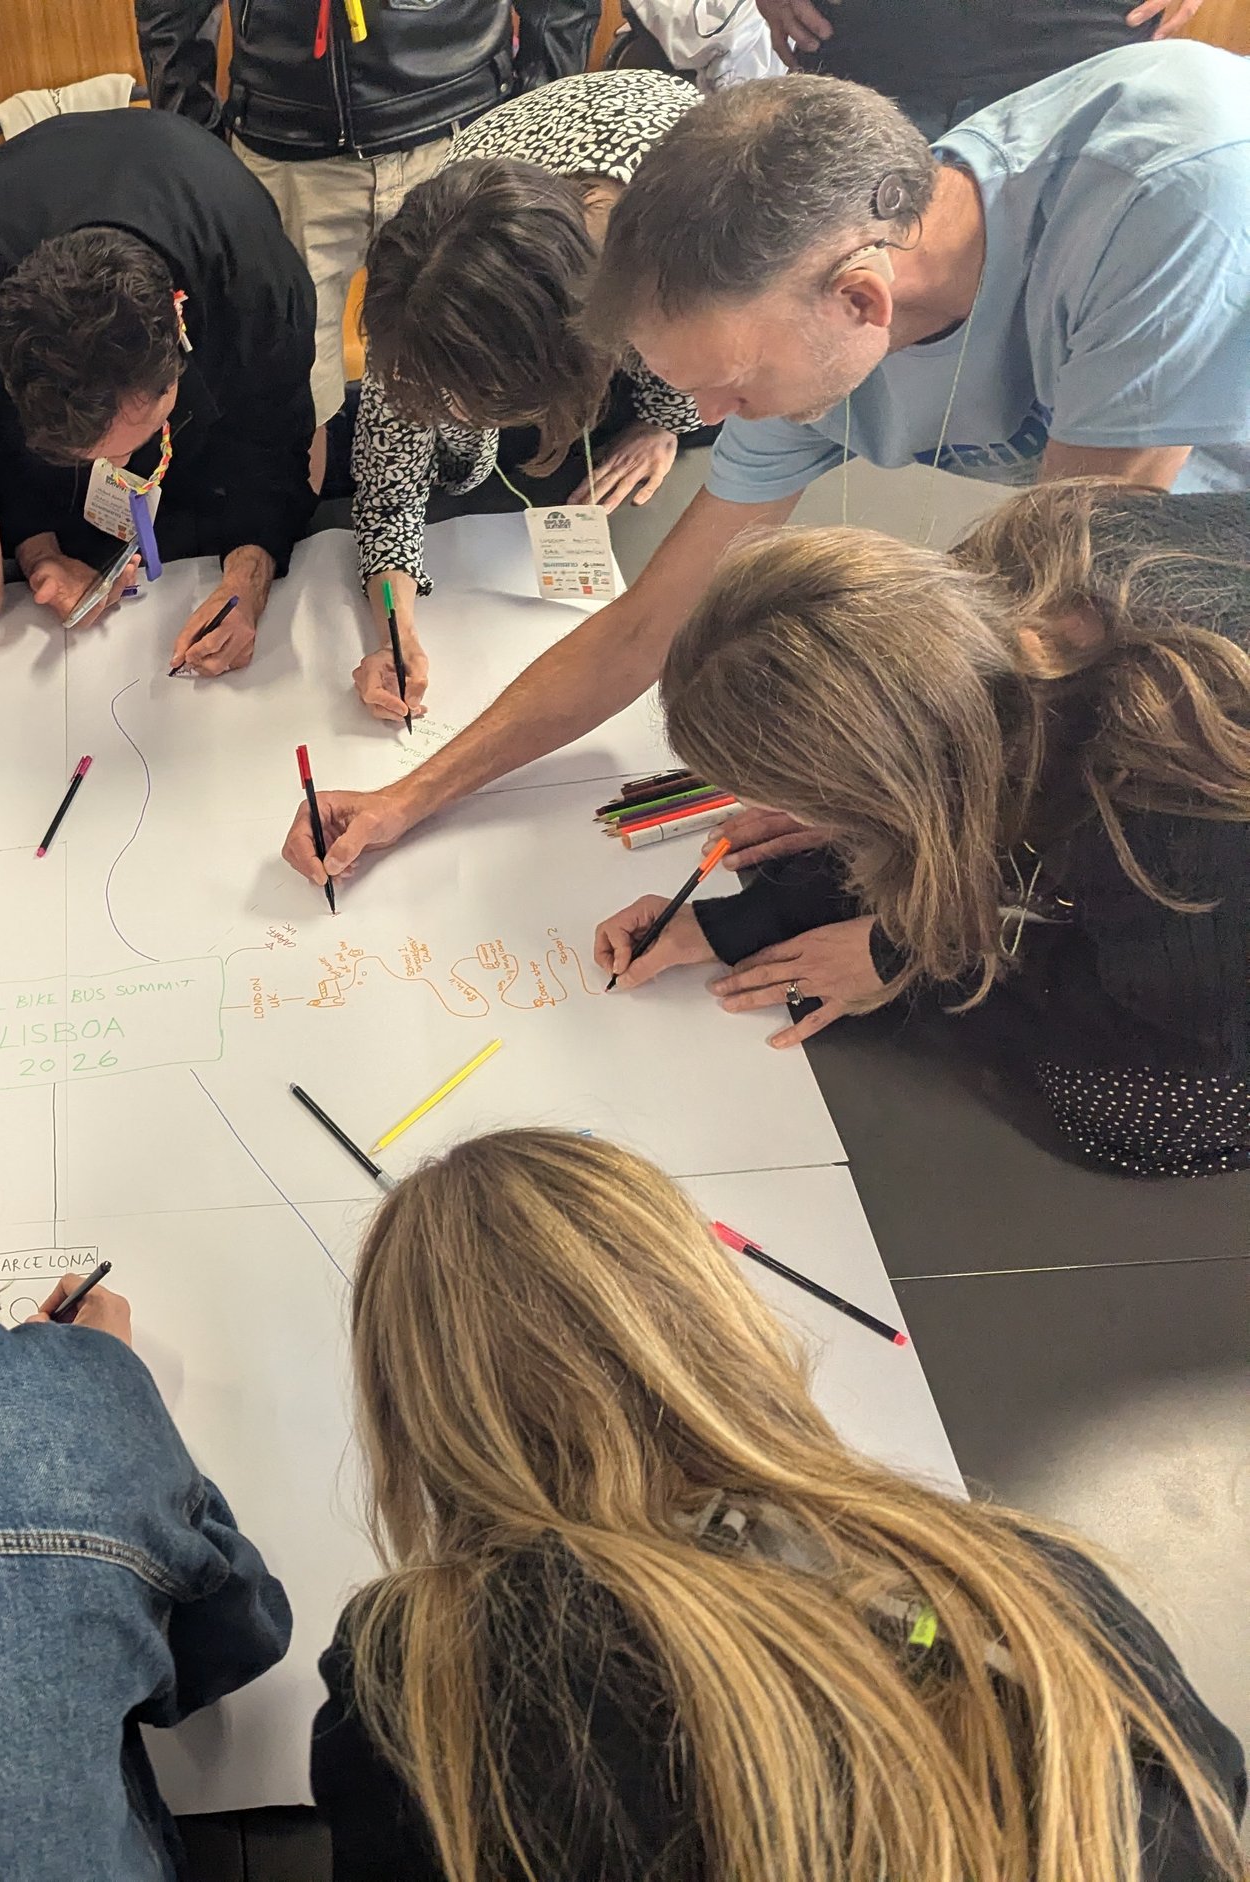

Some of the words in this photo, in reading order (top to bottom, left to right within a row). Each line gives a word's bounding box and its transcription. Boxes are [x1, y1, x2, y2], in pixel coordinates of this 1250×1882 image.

[16, 992, 59, 1009] BIKE
[71, 987, 106, 1004] BUS
[116, 979, 197, 996] SUMMIT
[250, 977, 265, 1019] LONDON
